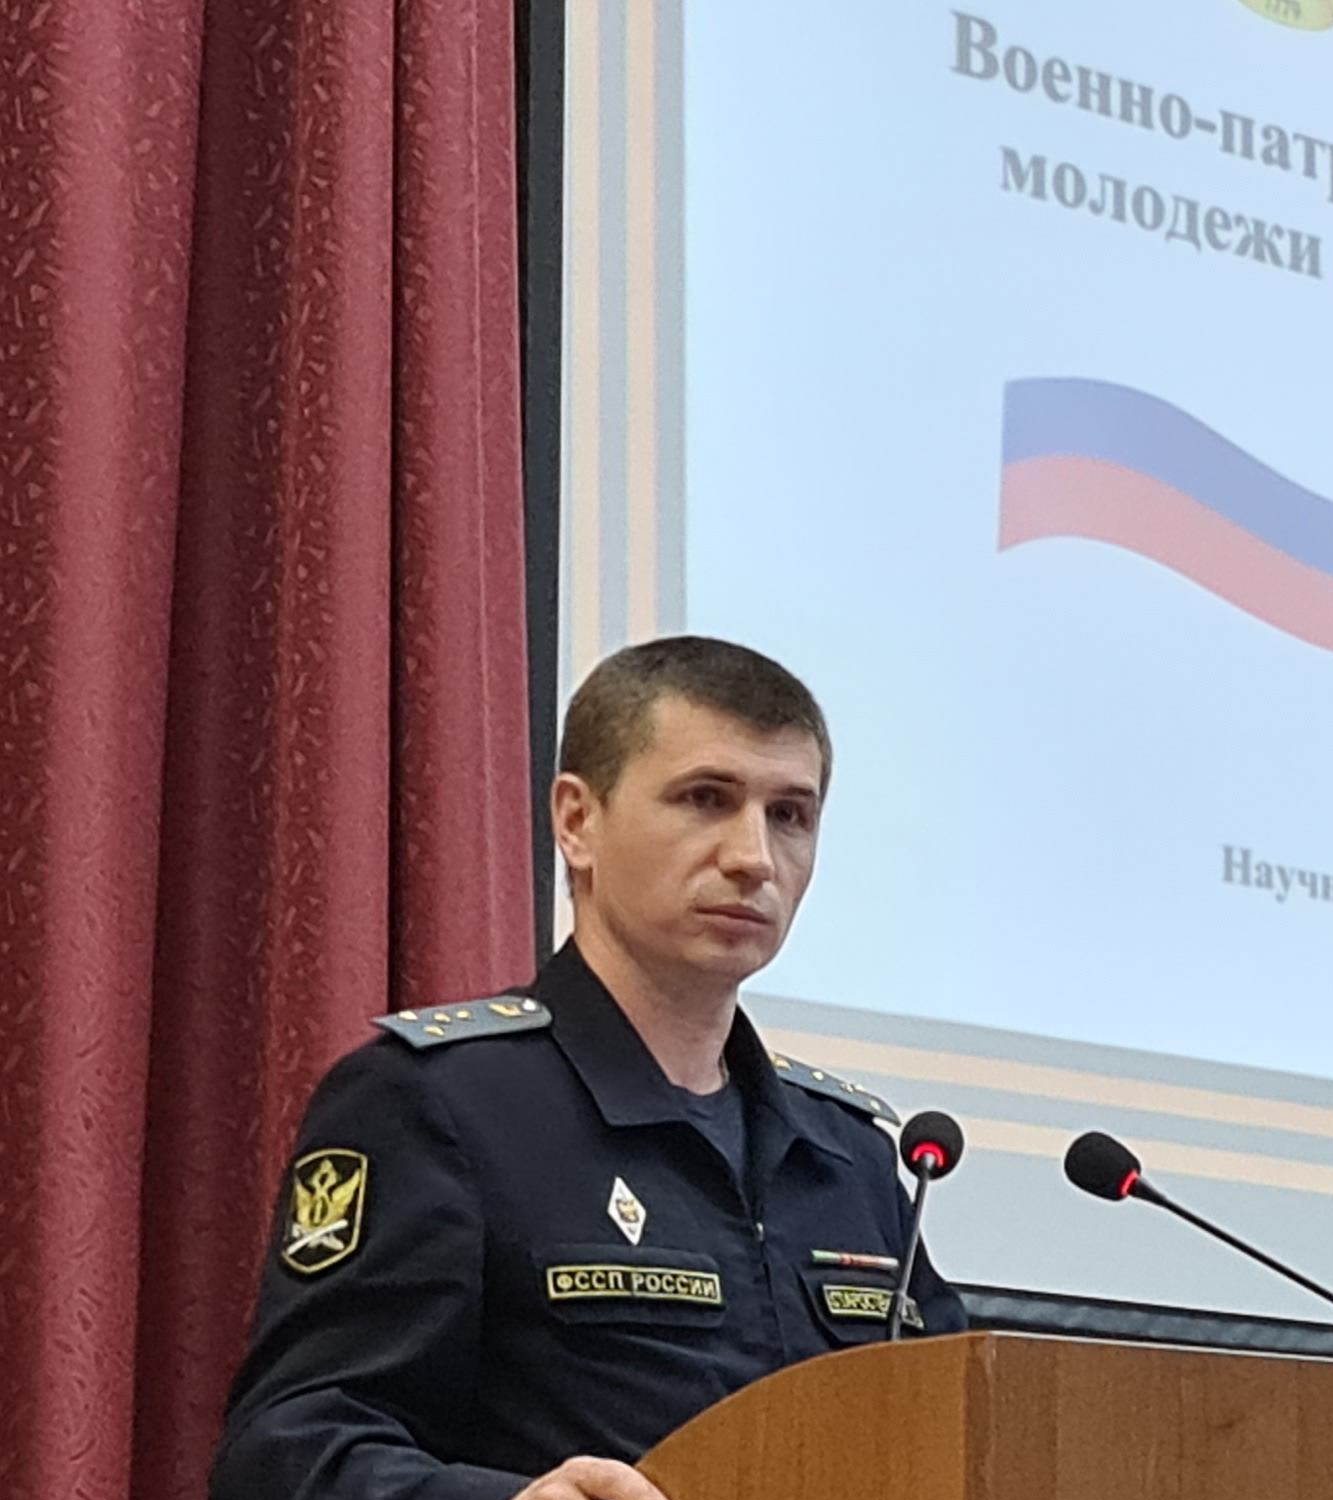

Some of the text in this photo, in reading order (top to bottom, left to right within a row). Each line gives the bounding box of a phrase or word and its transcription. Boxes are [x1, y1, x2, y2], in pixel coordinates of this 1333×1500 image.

[1000, 145, 1322, 280] молодежи
[556, 1271, 716, 1297] ФССП РОССИИ
